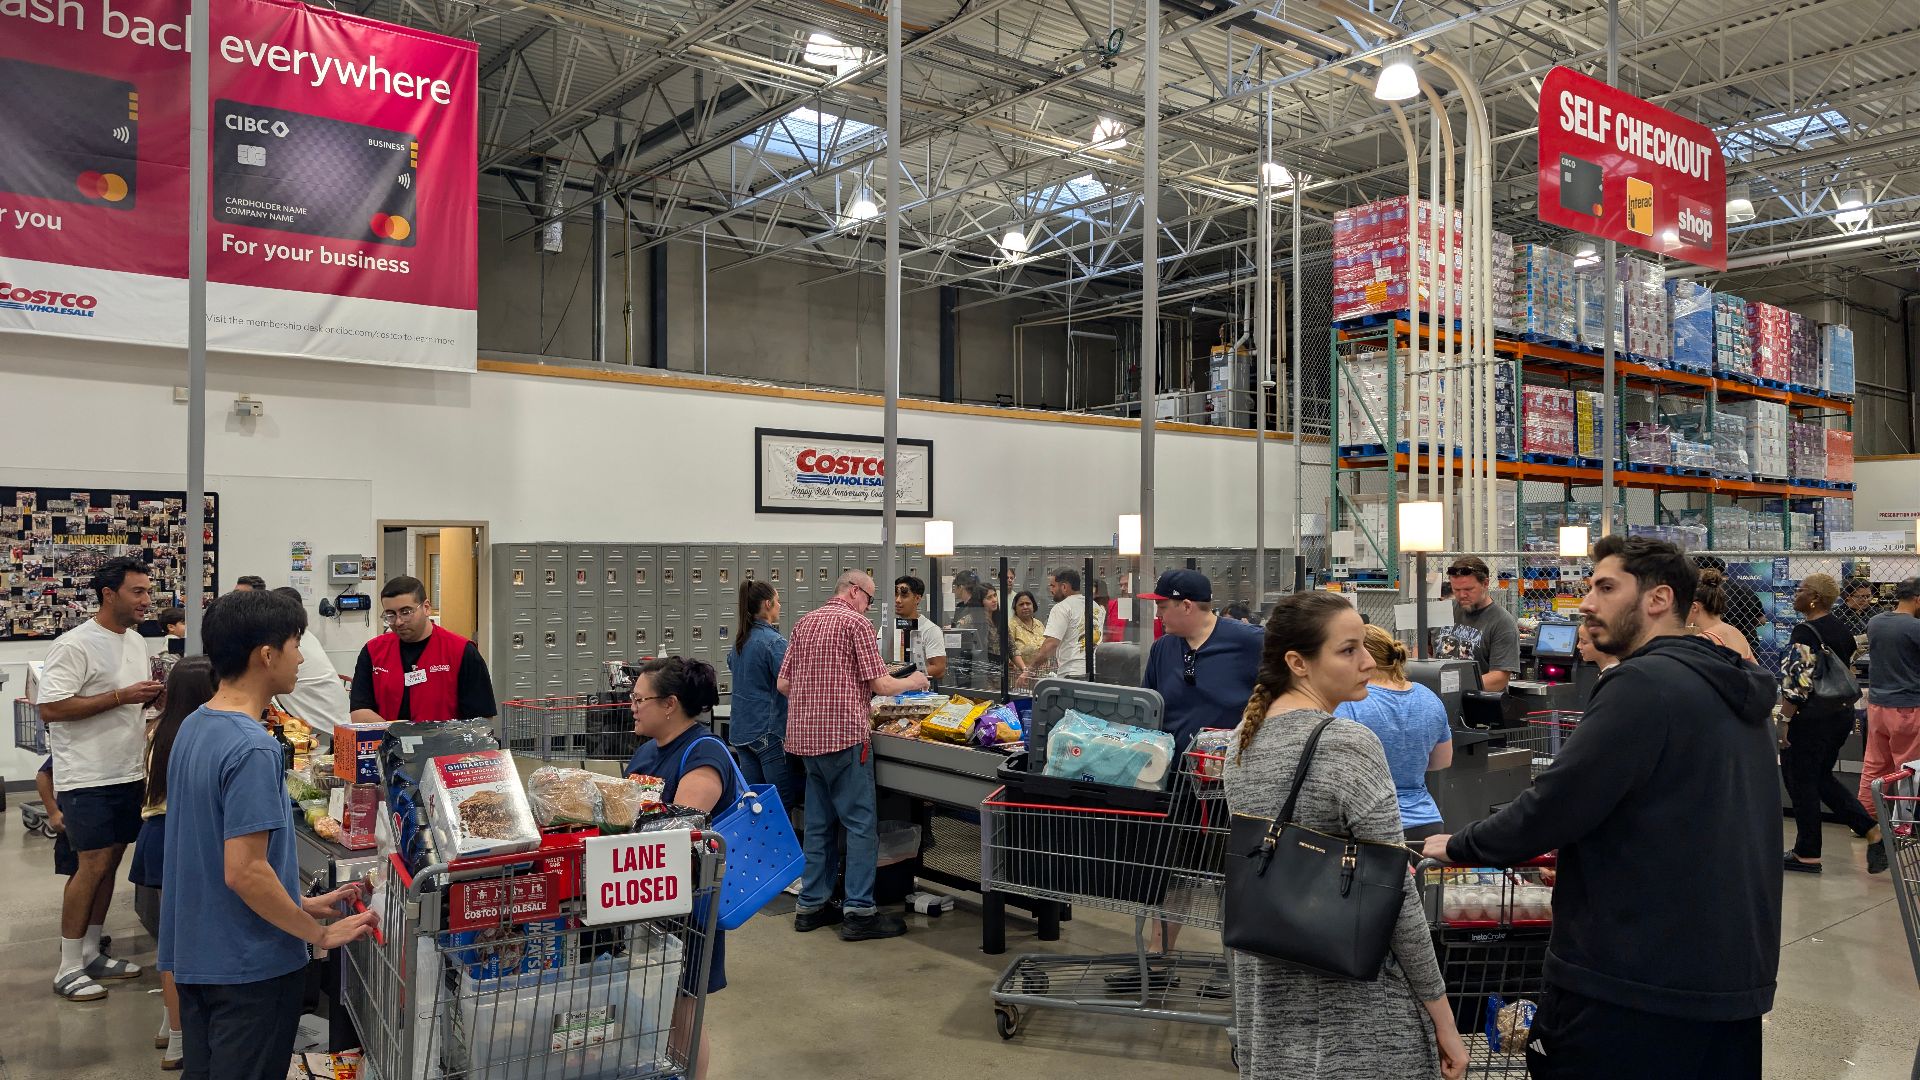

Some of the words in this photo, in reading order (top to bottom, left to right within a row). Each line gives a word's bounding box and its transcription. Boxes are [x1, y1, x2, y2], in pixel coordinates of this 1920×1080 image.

[220, 35, 450, 104] everywhere
[225, 114, 269, 134] CIBC
[368, 138, 405, 151] BUSINESS
[1560, 90, 1611, 144] SELF
[1615, 112, 1712, 182] CHECKOUT
[225, 196, 281, 212] CARDHOLDER
[282, 204, 307, 216] NAME
[225, 206, 268, 220] COMPANY
[269, 213, 295, 223] NAME
[14, 210, 62, 230] you
[1678, 207, 1713, 243] shop
[222, 233, 258, 255] For
[263, 242, 314, 261] your
[320, 246, 410, 274] business
[0, 282, 98, 309] COSTCO
[23, 304, 95, 318] WHOLESALE
[206, 313, 227, 325] Visit
[228, 315, 244, 325] the
[246, 317, 302, 332] membership
[303, 322, 324, 333] desk
[828, 475, 885, 486] WHOLESA
[791, 485, 814, 498] Happy
[832, 487, 869, 500] Anniversary
[67, 534, 129, 545] ANNIVERSARY
[613, 843, 666, 873] LANE
[601, 875, 678, 908] CLOSED
[464, 907, 498, 920] COSTCO
